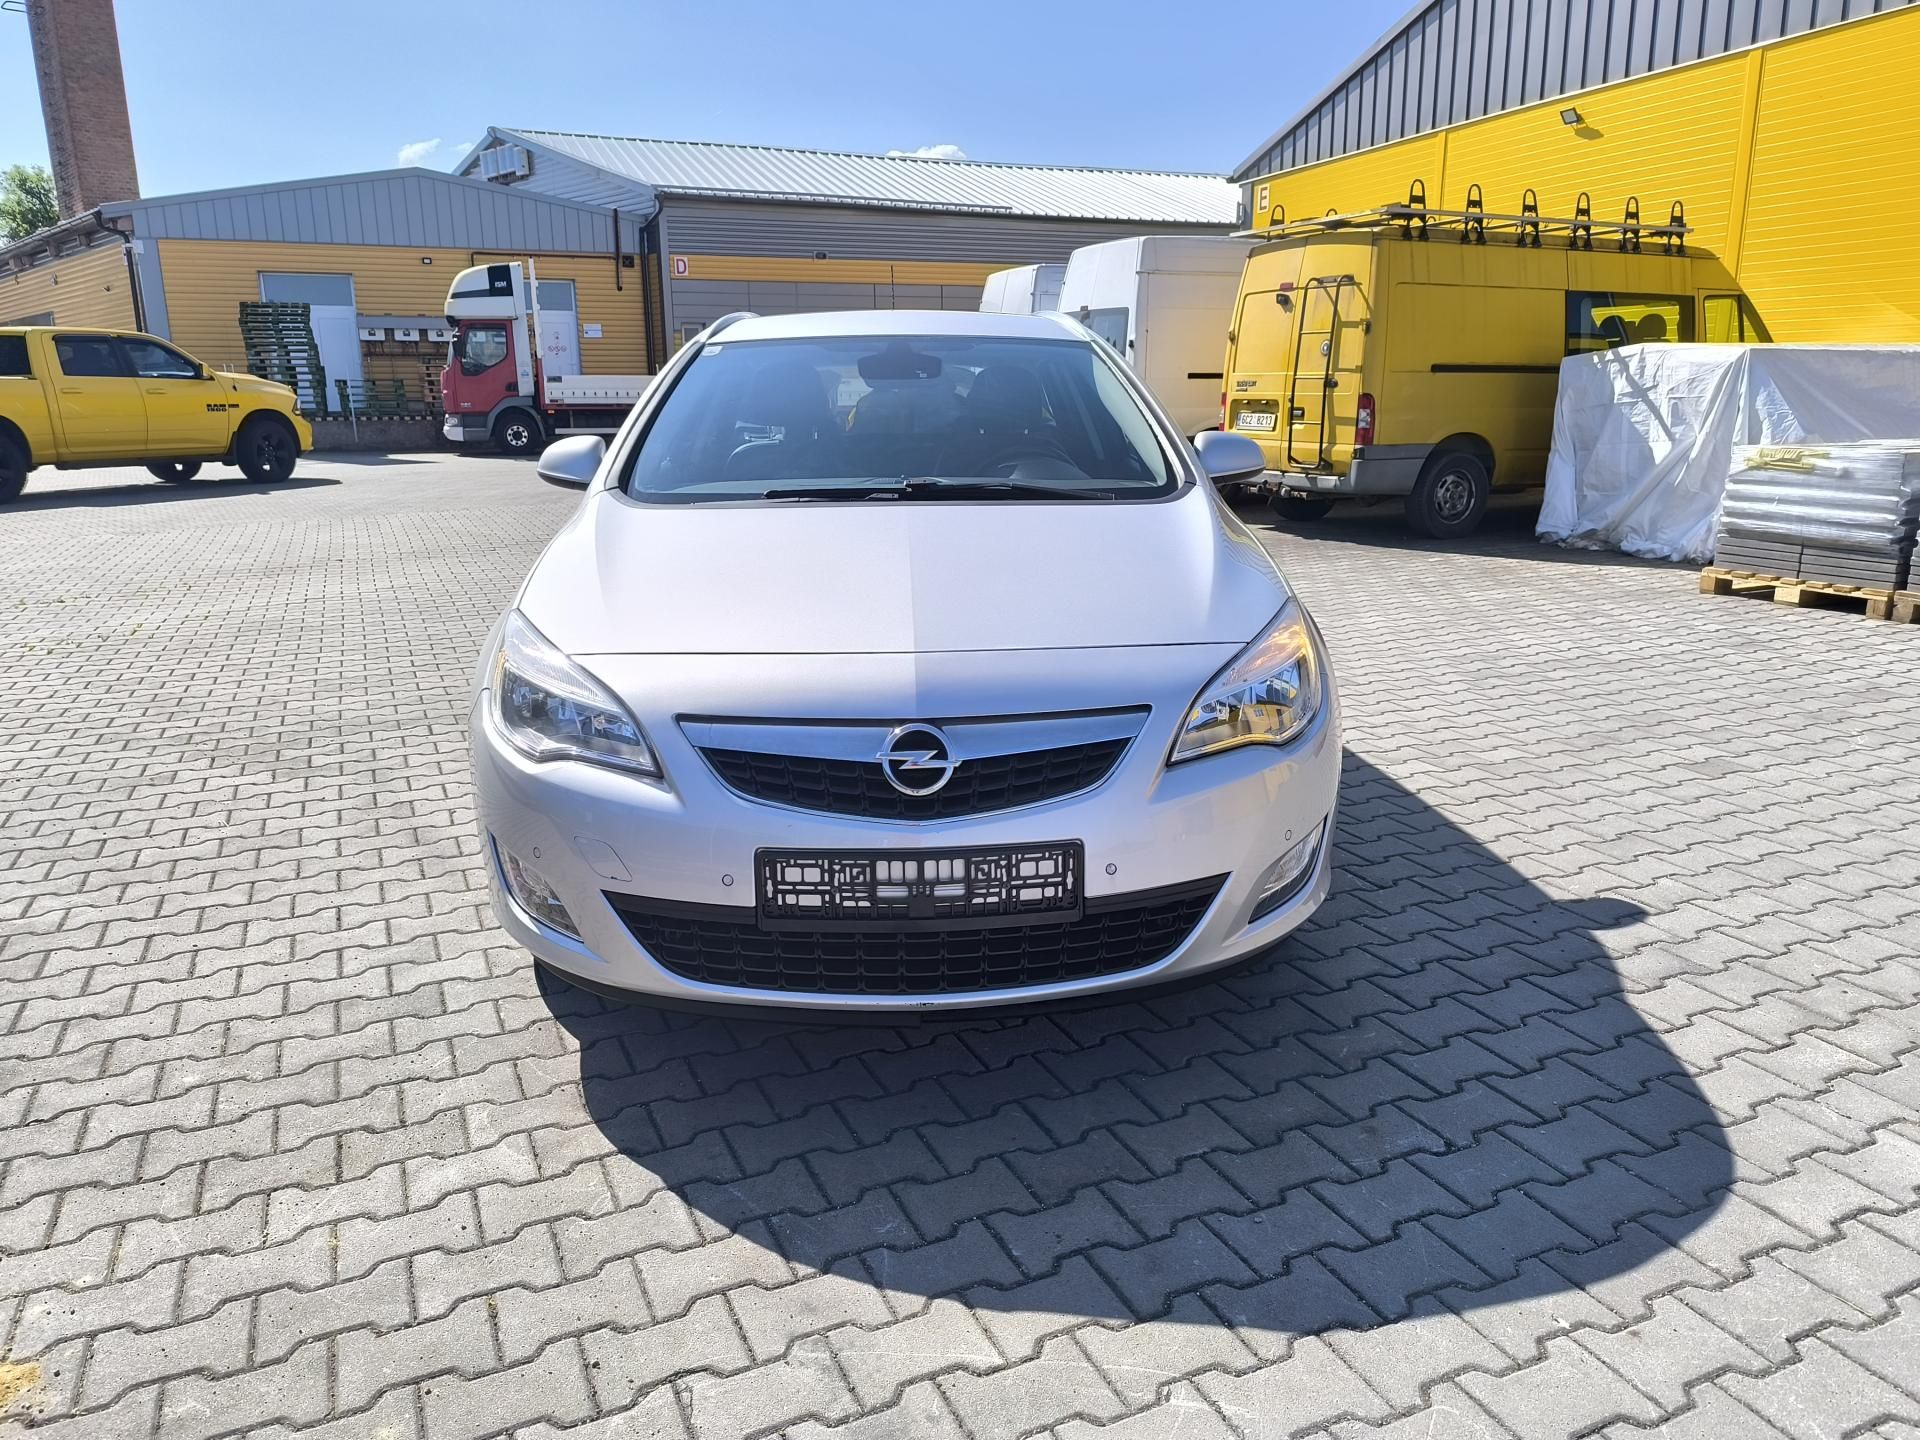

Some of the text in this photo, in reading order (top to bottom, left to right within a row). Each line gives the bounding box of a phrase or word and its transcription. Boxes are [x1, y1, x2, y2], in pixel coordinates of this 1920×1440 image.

[1260, 187, 1268, 211] E
[676, 258, 687, 274] D
[1241, 414, 1273, 426] 6C2 8213
